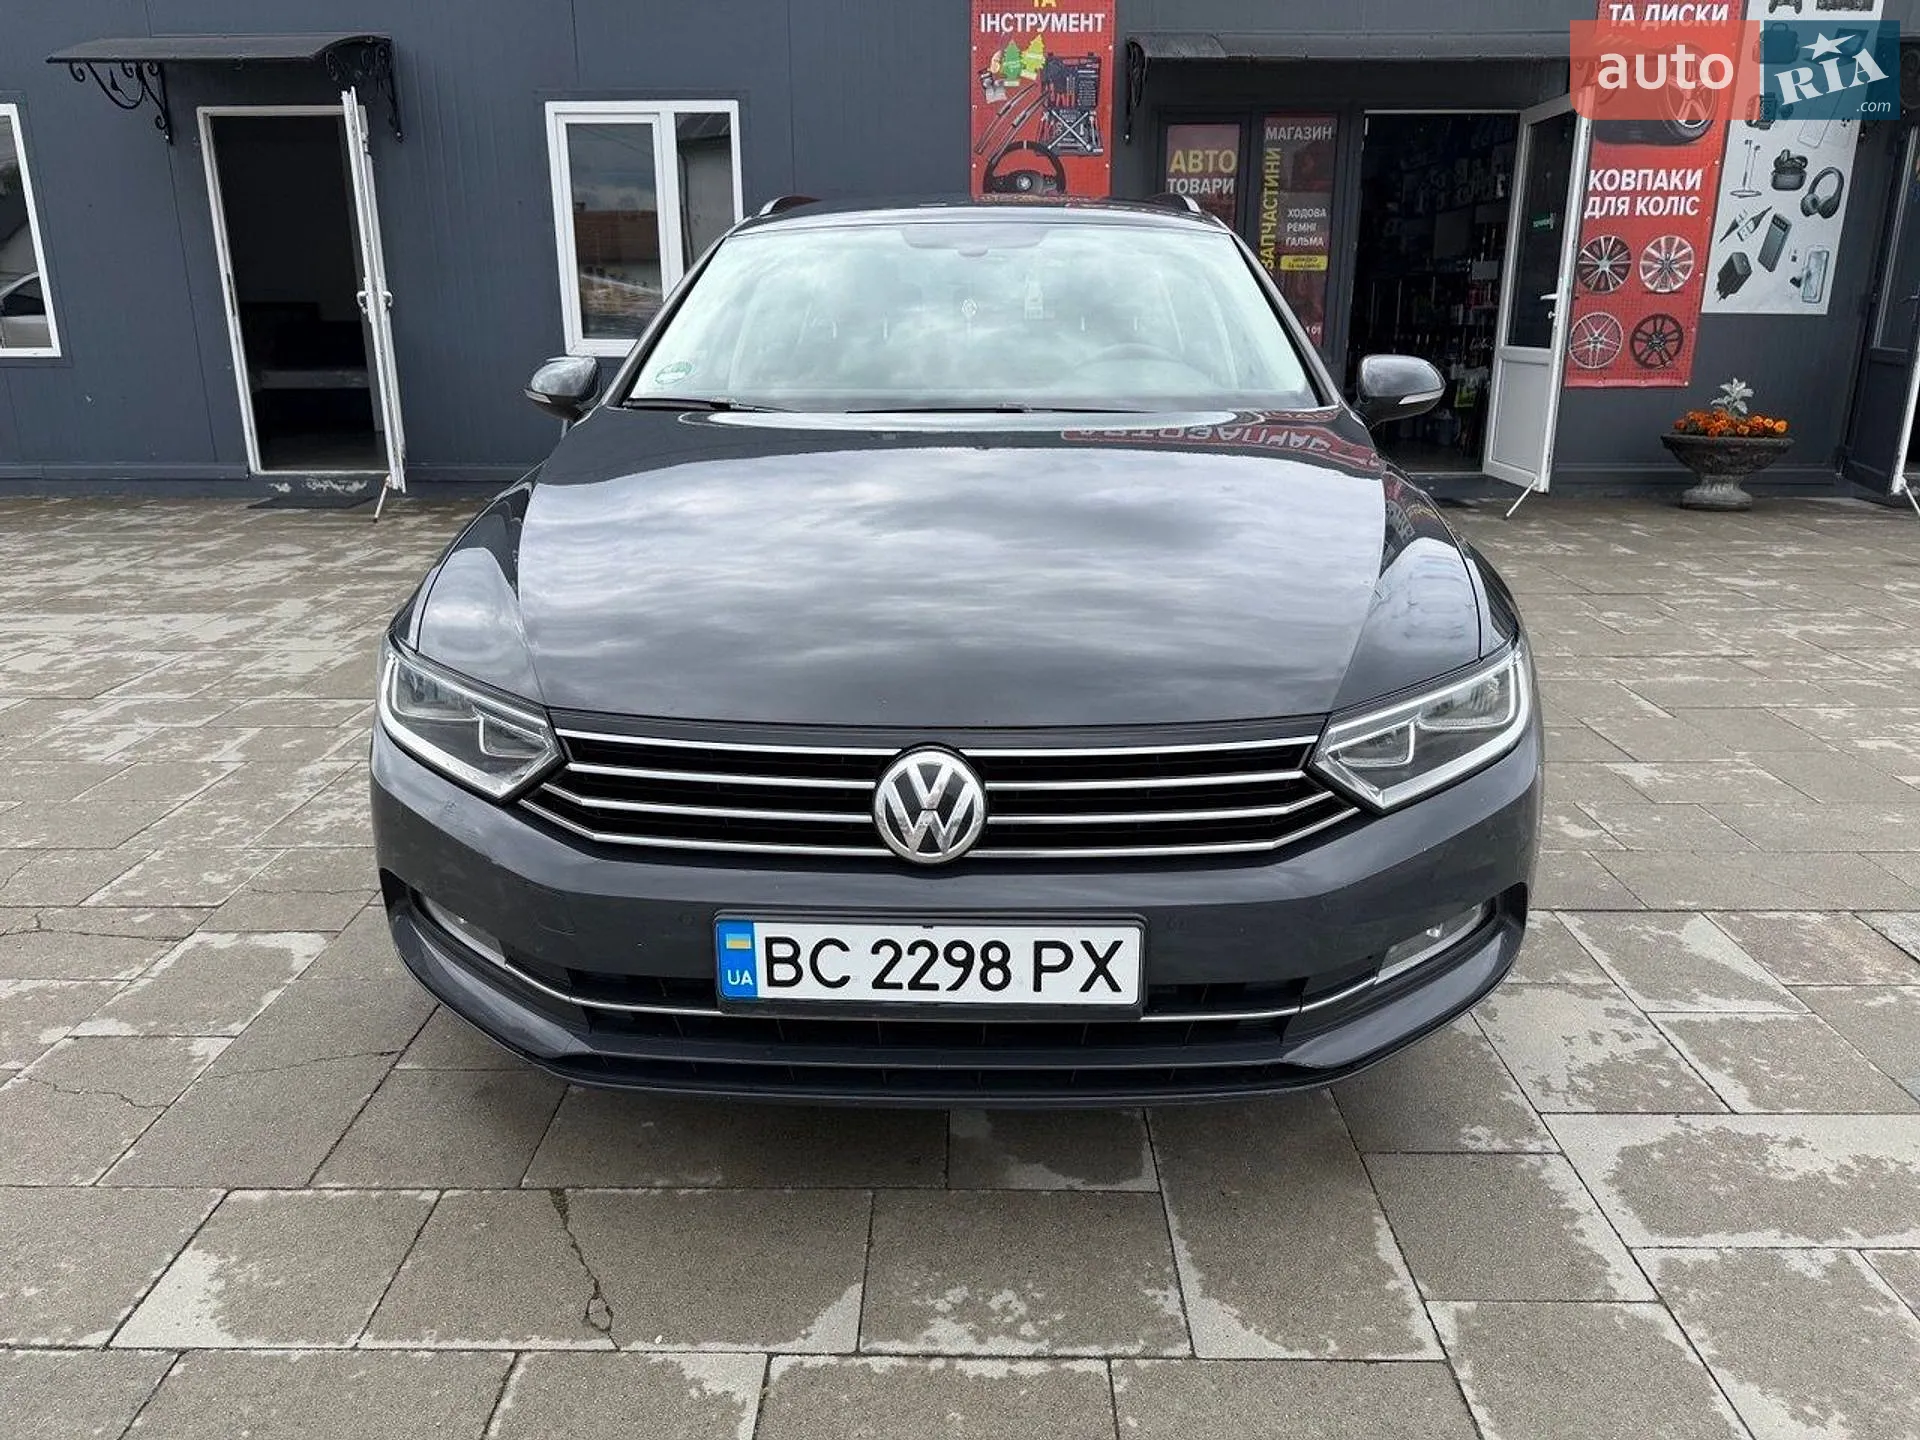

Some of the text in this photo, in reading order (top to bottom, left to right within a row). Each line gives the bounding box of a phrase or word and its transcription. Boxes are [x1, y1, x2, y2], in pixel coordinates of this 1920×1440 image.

[980, 12, 1106, 33] ІНСТРУМЕНТ
[1608, 3, 1730, 31] ТА ДИСКИ
[1264, 126, 1333, 141] МАГАЗИН
[1169, 150, 1238, 174] АВТО
[1167, 177, 1236, 195] ТОВАРИ
[1588, 168, 1704, 191] КОВПАКИ
[1287, 208, 1327, 219] ХОДОВА
[1584, 196, 1701, 219] ДЛЯ КОЛІС
[1286, 222, 1317, 233] РЕМНІ
[1285, 236, 1325, 247] ГАЛЬМА
[765, 936, 1124, 993] BC 2298 PX
[727, 969, 753, 986] UA
